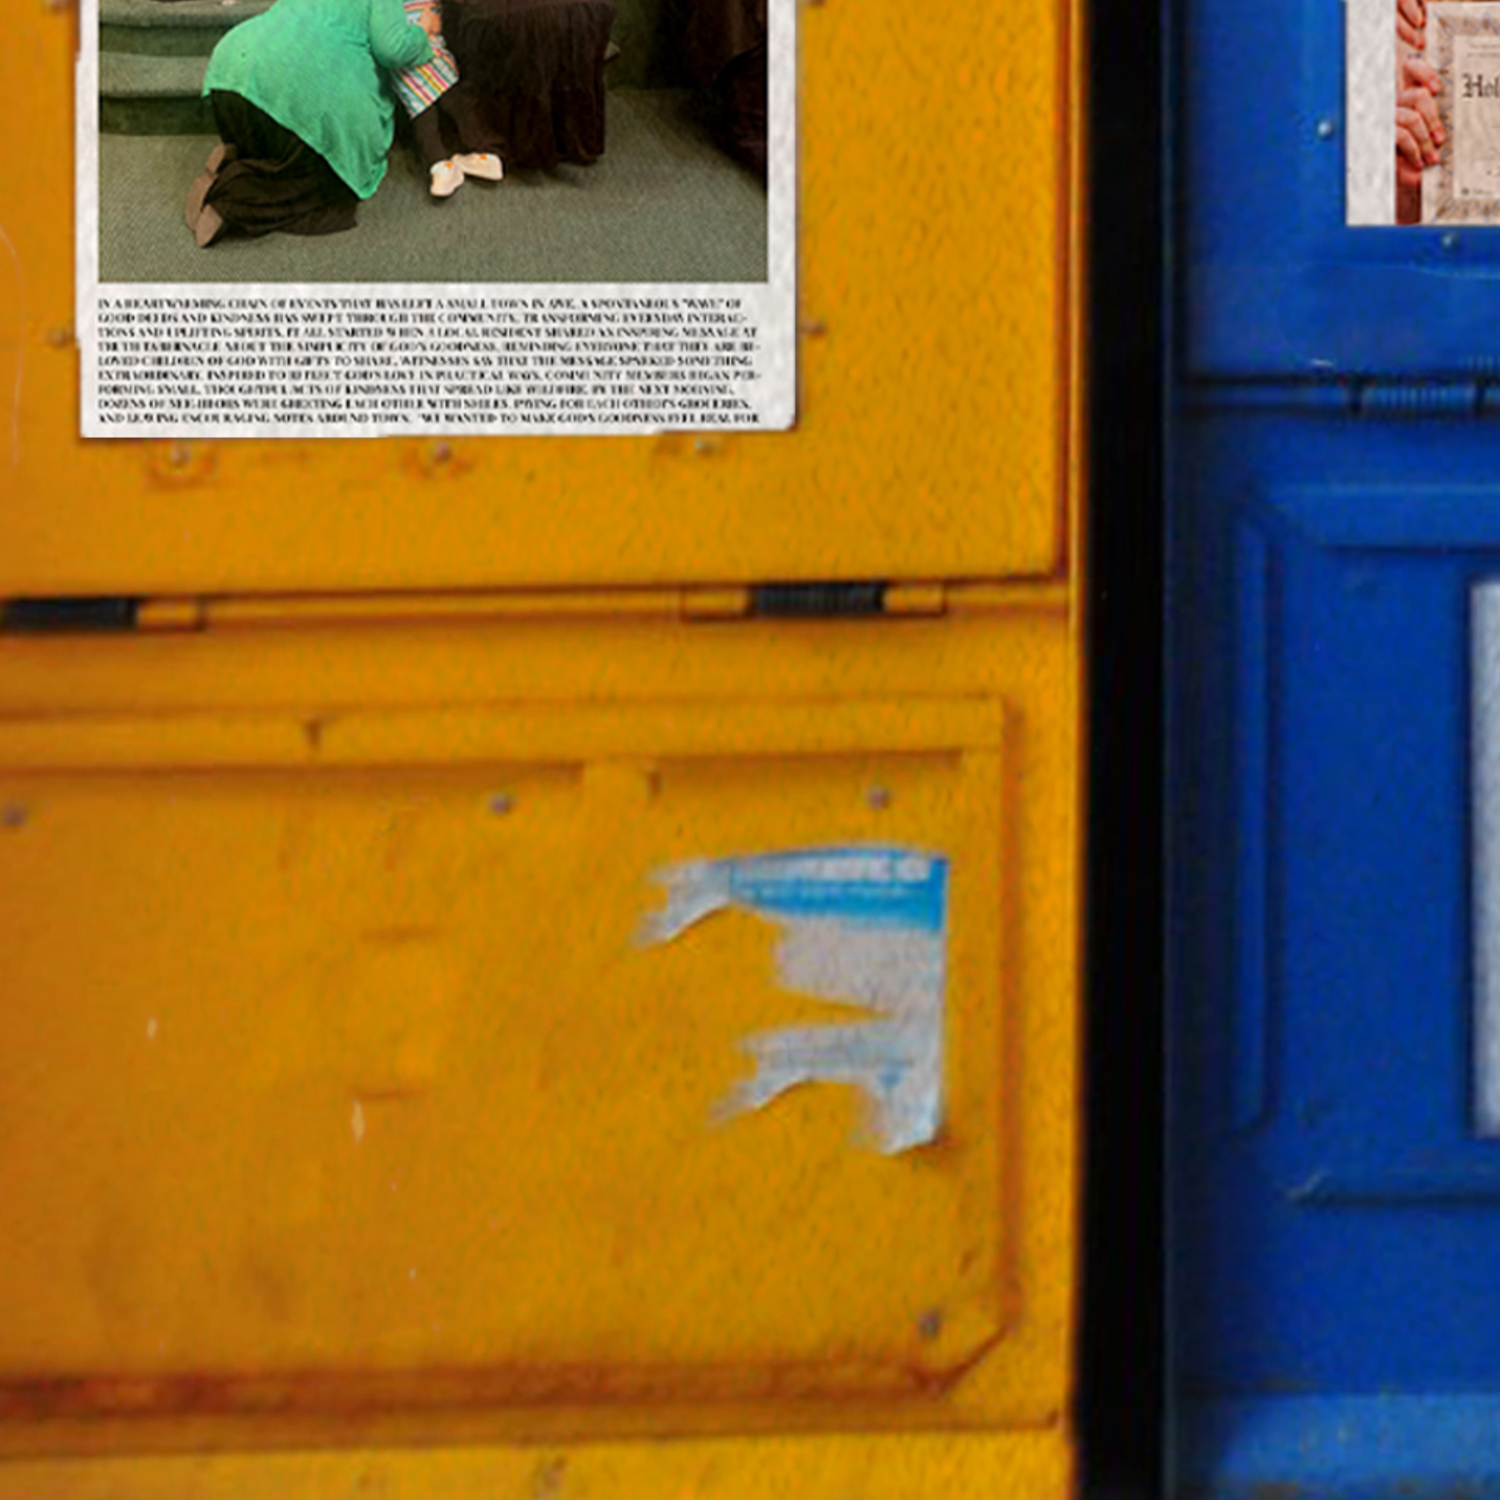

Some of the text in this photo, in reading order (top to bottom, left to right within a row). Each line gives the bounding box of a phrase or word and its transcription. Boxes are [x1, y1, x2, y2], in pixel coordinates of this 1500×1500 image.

[98, 313, 135, 324] GOOD
[182, 313, 207, 324] AND
[210, 313, 271, 324] KINDNESS
[347, 313, 409, 324] THROUGH
[411, 313, 436, 324] THE
[99, 414, 125, 424] AND
[127, 414, 179, 424] LEAVING
[273, 414, 314, 424] NOTES
[319, 414, 369, 424] AROUND
[445, 414, 498, 424] WANTED
[501, 414, 518, 424] TO
[598, 414, 665, 424] GOODNESS
[733, 414, 760, 424] FOR
